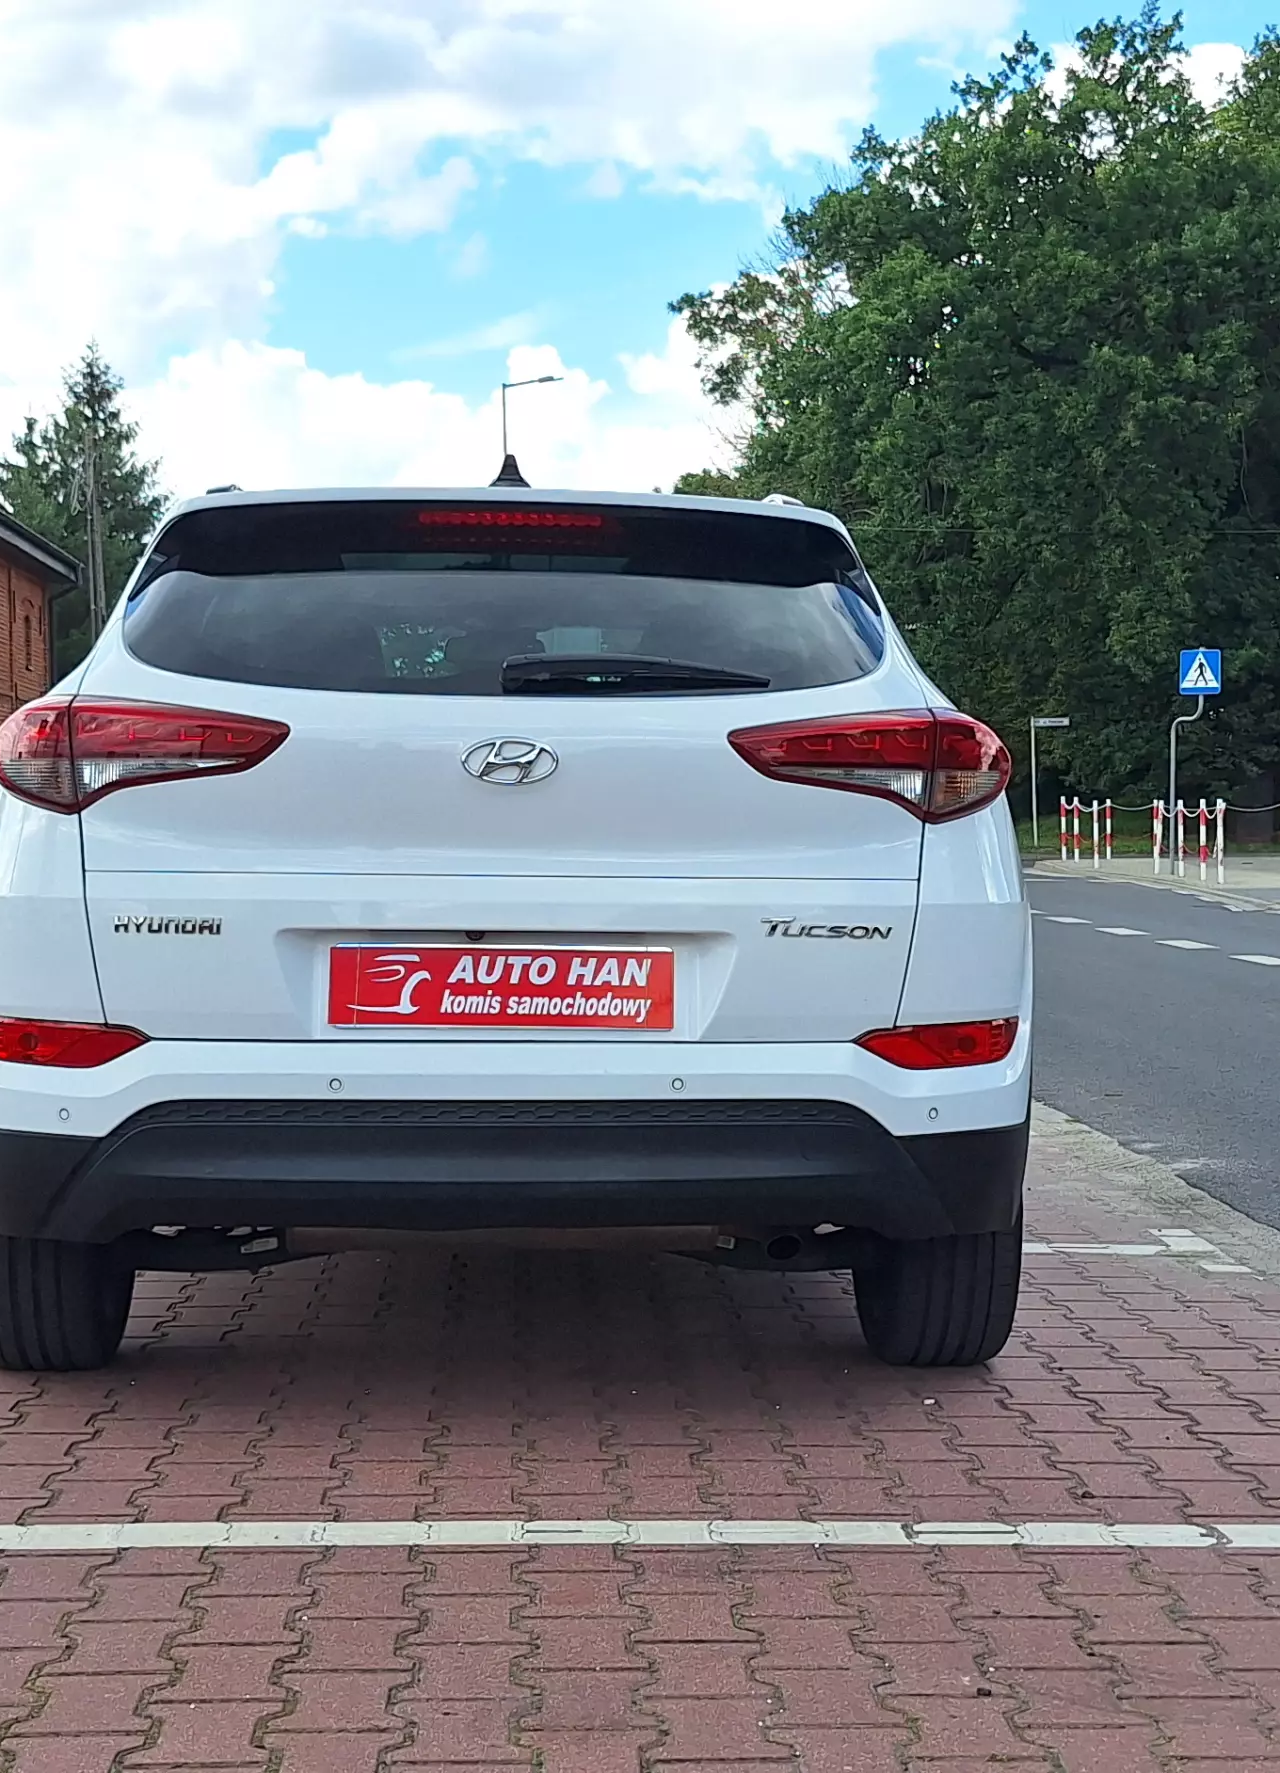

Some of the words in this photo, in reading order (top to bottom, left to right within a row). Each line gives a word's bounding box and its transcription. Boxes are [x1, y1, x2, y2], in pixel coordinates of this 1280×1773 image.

[113, 915, 222, 935] HYUNDAI
[760, 915, 893, 940] TUCSON
[447, 955, 556, 986] AUTO
[567, 956, 651, 987] HAN
[439, 989, 502, 1015] komis
[506, 991, 652, 1023] samochodowy
